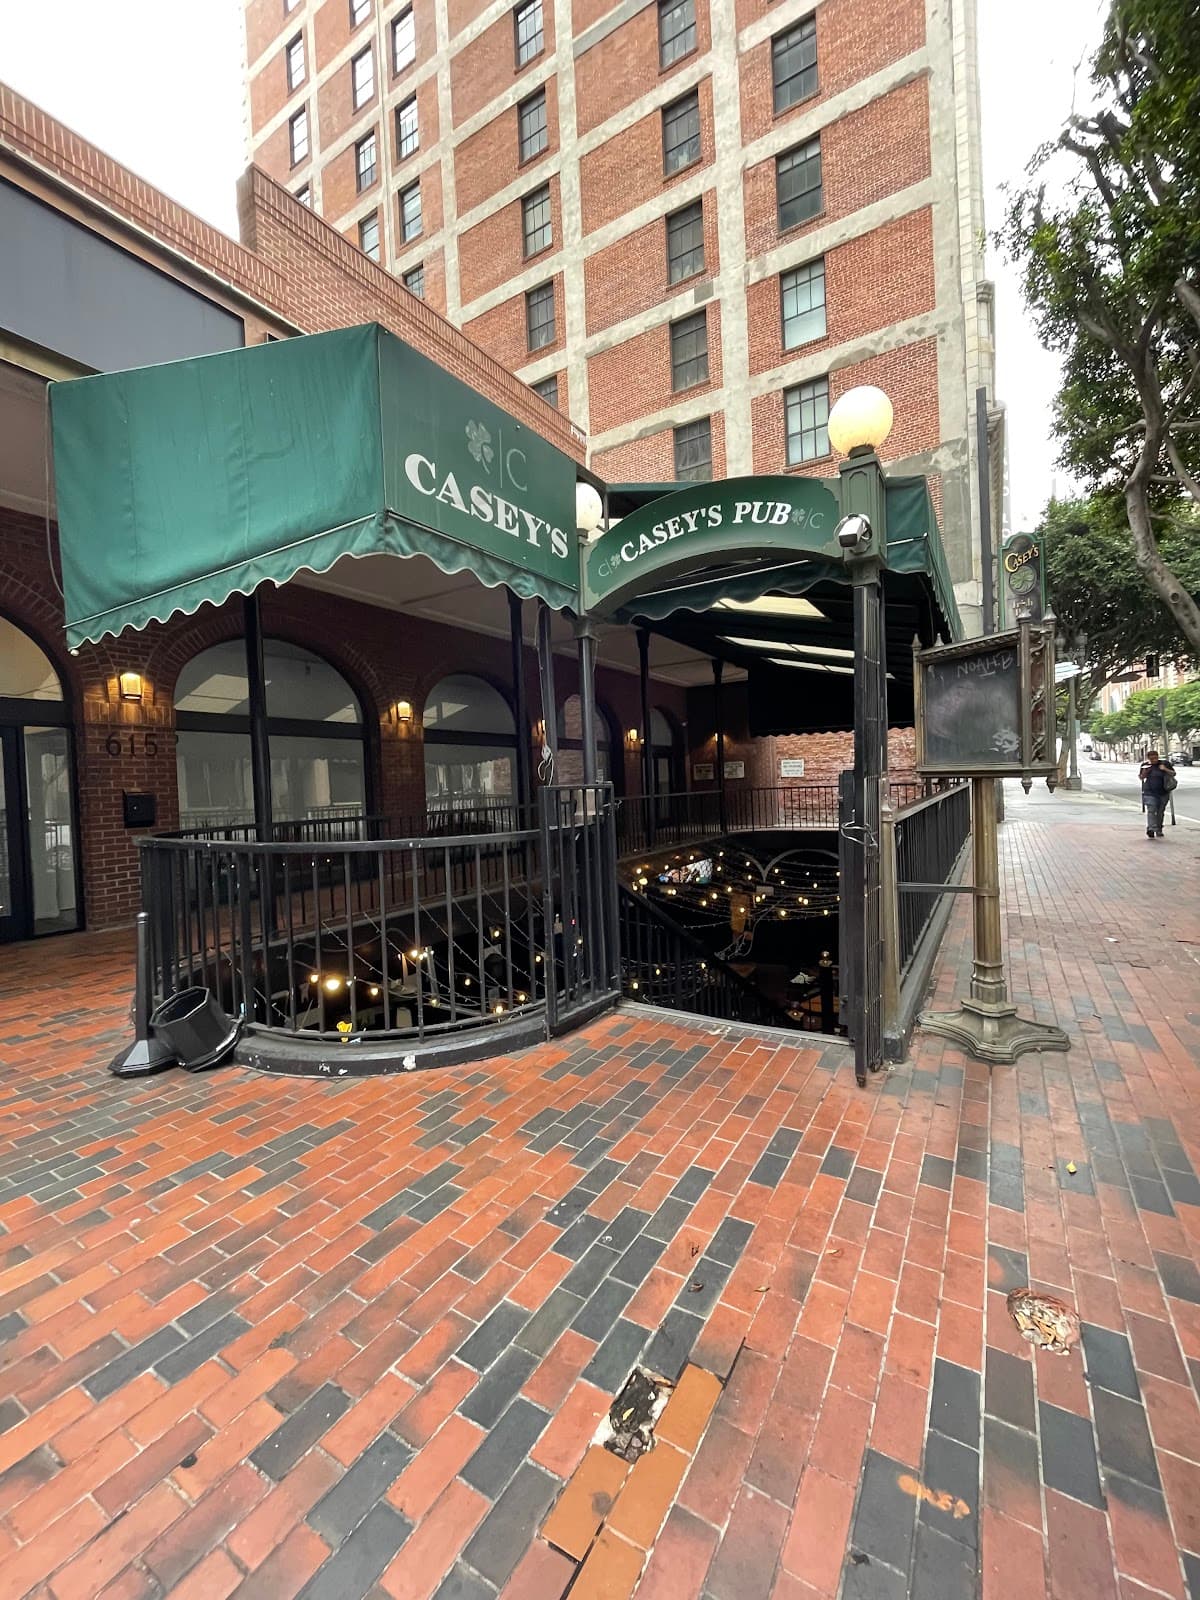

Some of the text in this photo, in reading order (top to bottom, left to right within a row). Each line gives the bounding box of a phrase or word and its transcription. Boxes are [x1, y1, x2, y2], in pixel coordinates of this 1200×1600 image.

[404, 453, 569, 559] CASEY'S
[620, 504, 723, 562] CASEY'S
[732, 501, 792, 525] PUB
[105, 732, 158, 757] 615
